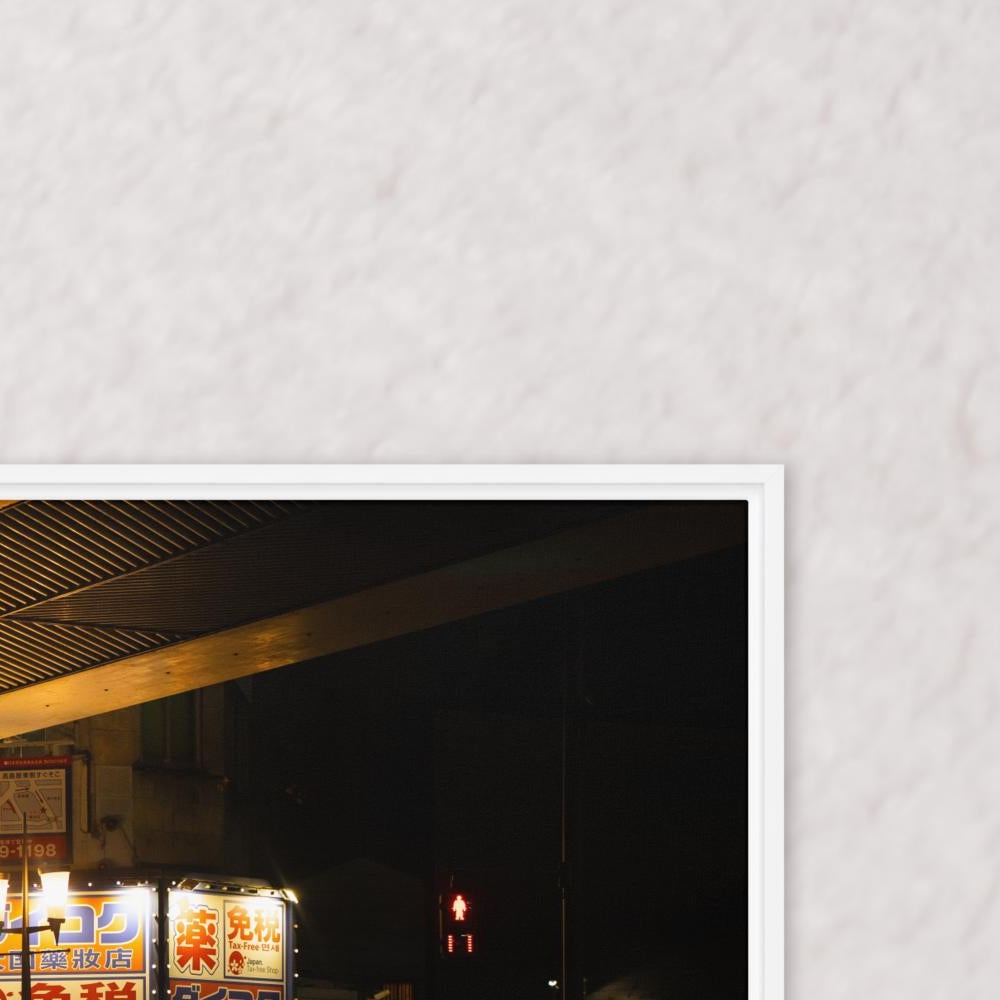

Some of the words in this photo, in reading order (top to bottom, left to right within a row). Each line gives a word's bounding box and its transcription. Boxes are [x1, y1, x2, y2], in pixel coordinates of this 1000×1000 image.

[176, 908, 217, 972] 薬
[227, 905, 281, 943] 免税
[228, 940, 260, 952] Tax-Free
